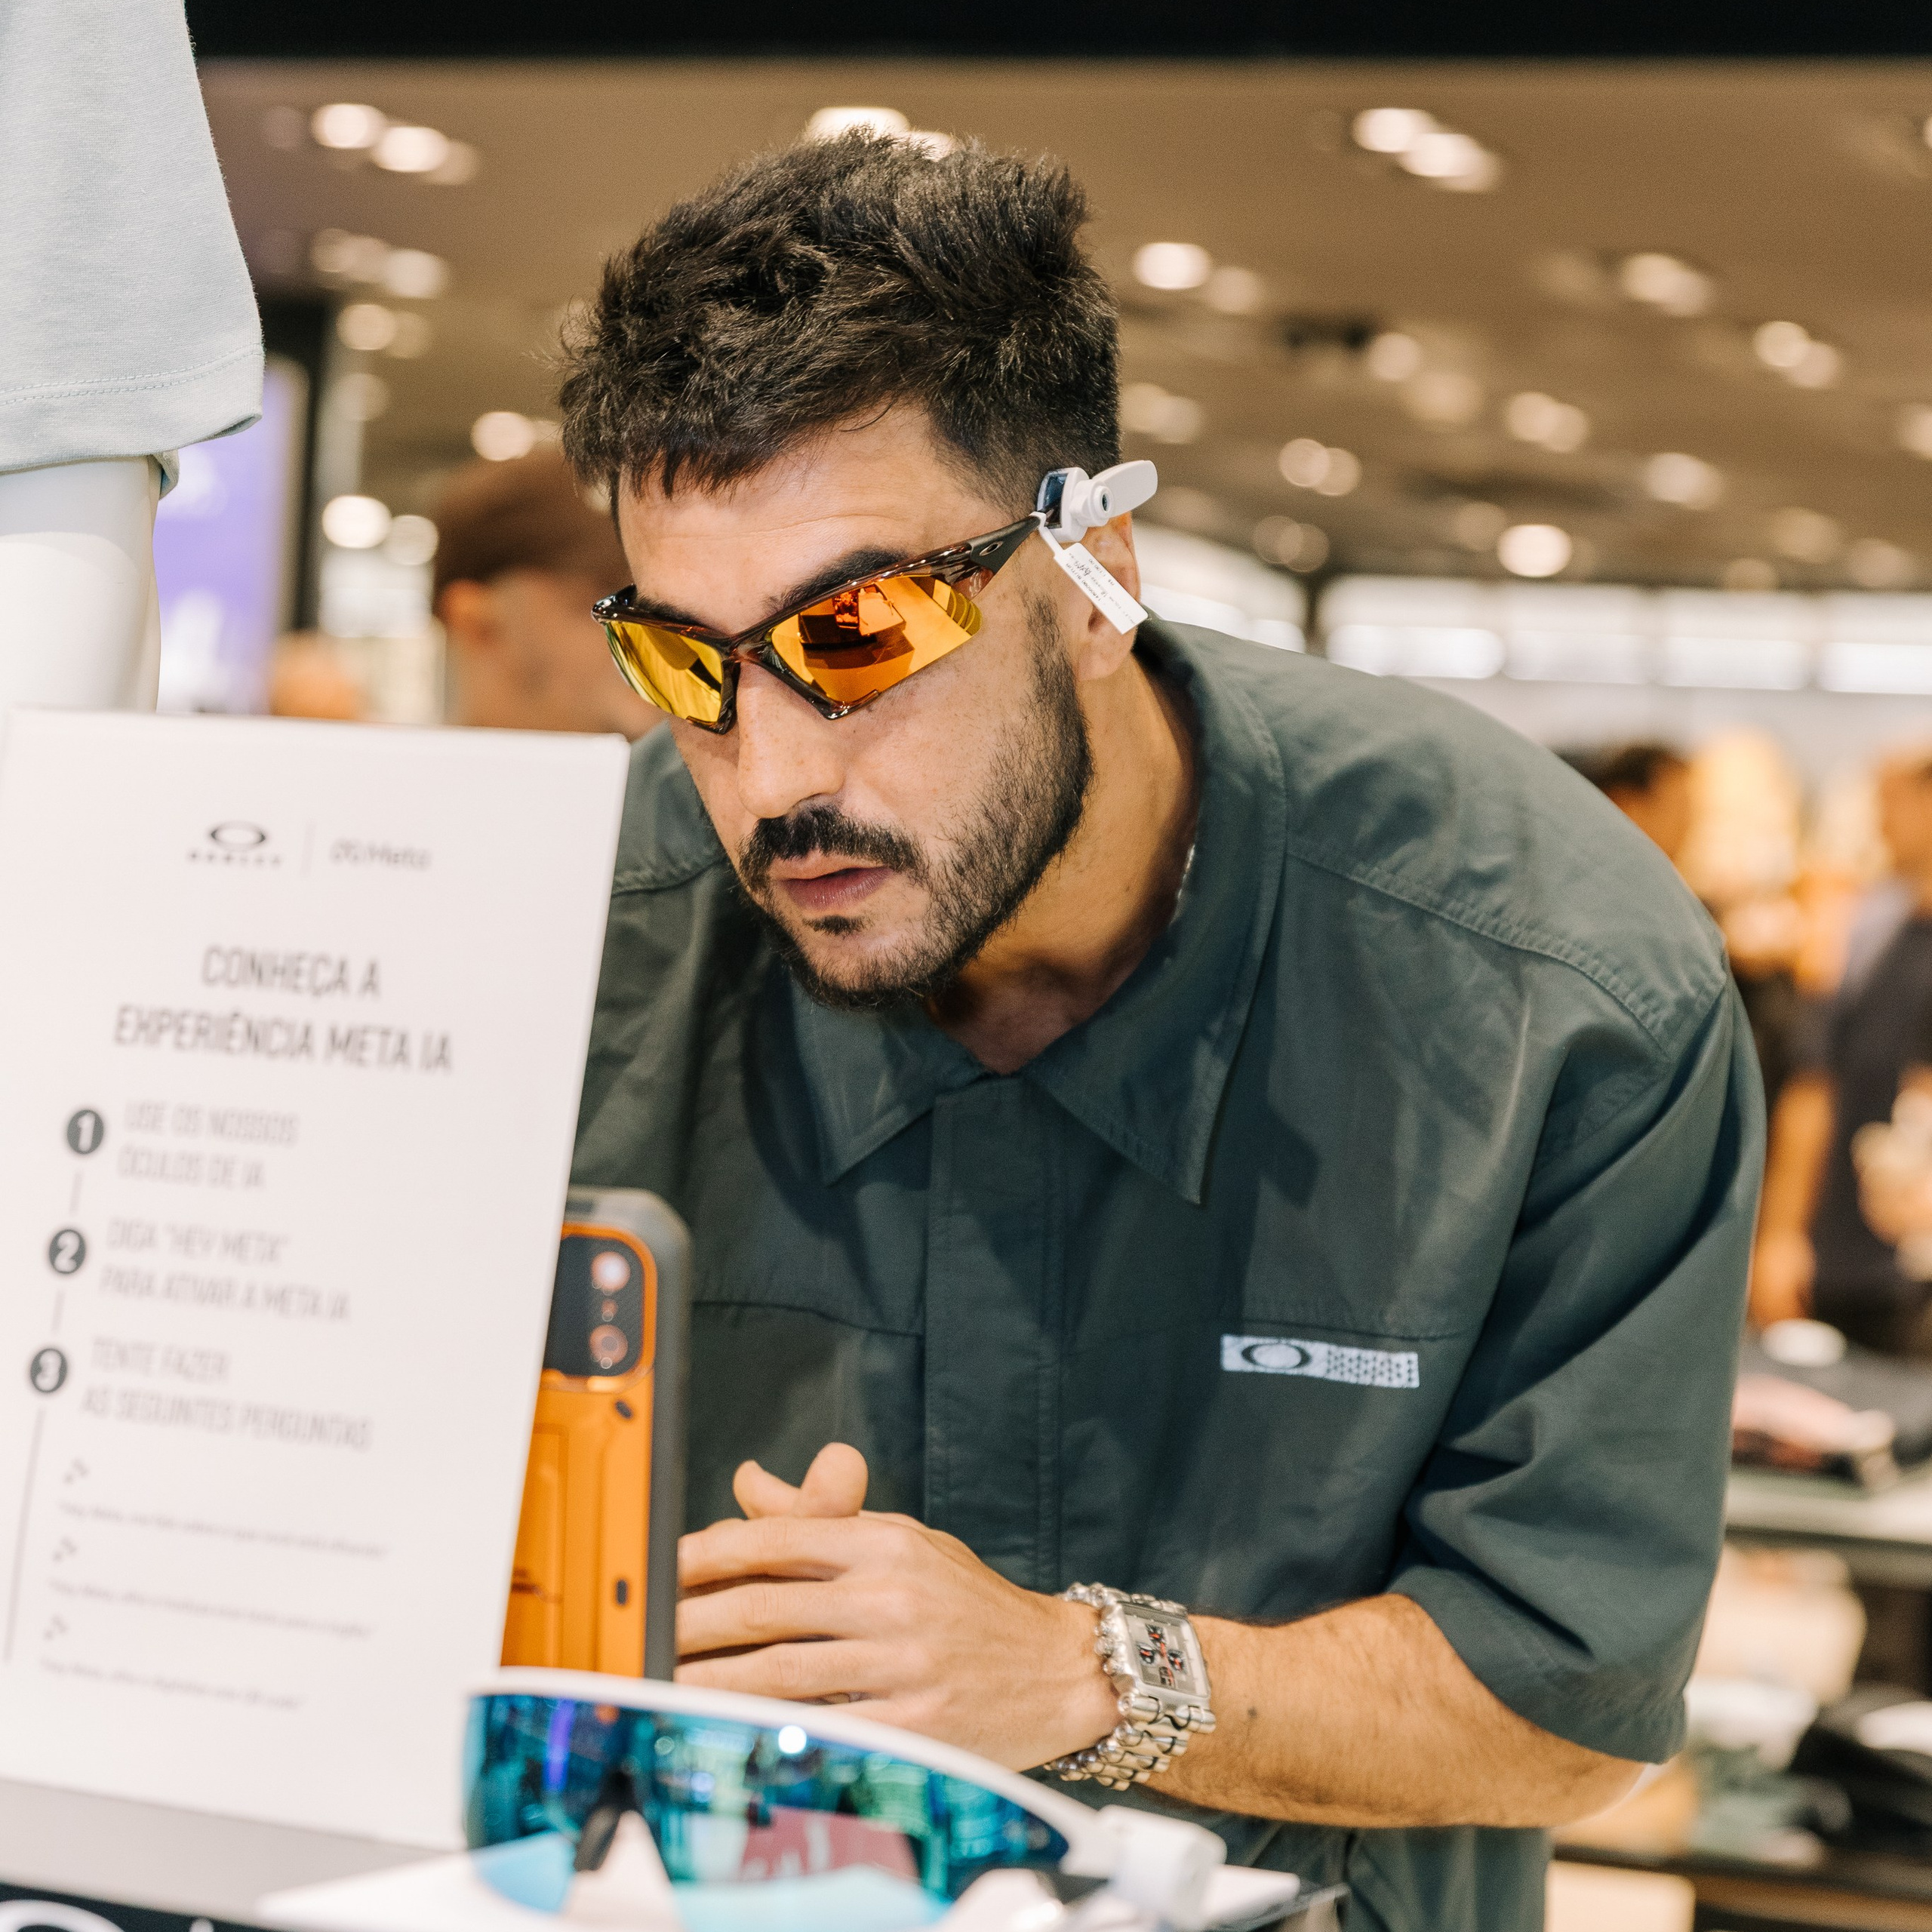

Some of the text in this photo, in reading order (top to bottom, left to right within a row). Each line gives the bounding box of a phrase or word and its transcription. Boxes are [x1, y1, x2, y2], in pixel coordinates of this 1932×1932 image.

[202, 943, 350, 998] CONHEÇA
[113, 1002, 314, 1060] EXPERIÊNCIA
[325, 1020, 411, 1069] META
[77, 1112, 95, 1149] 1
[57, 1234, 80, 1272] 2
[263, 1283, 321, 1318] META
[36, 1353, 60, 1390] 3
